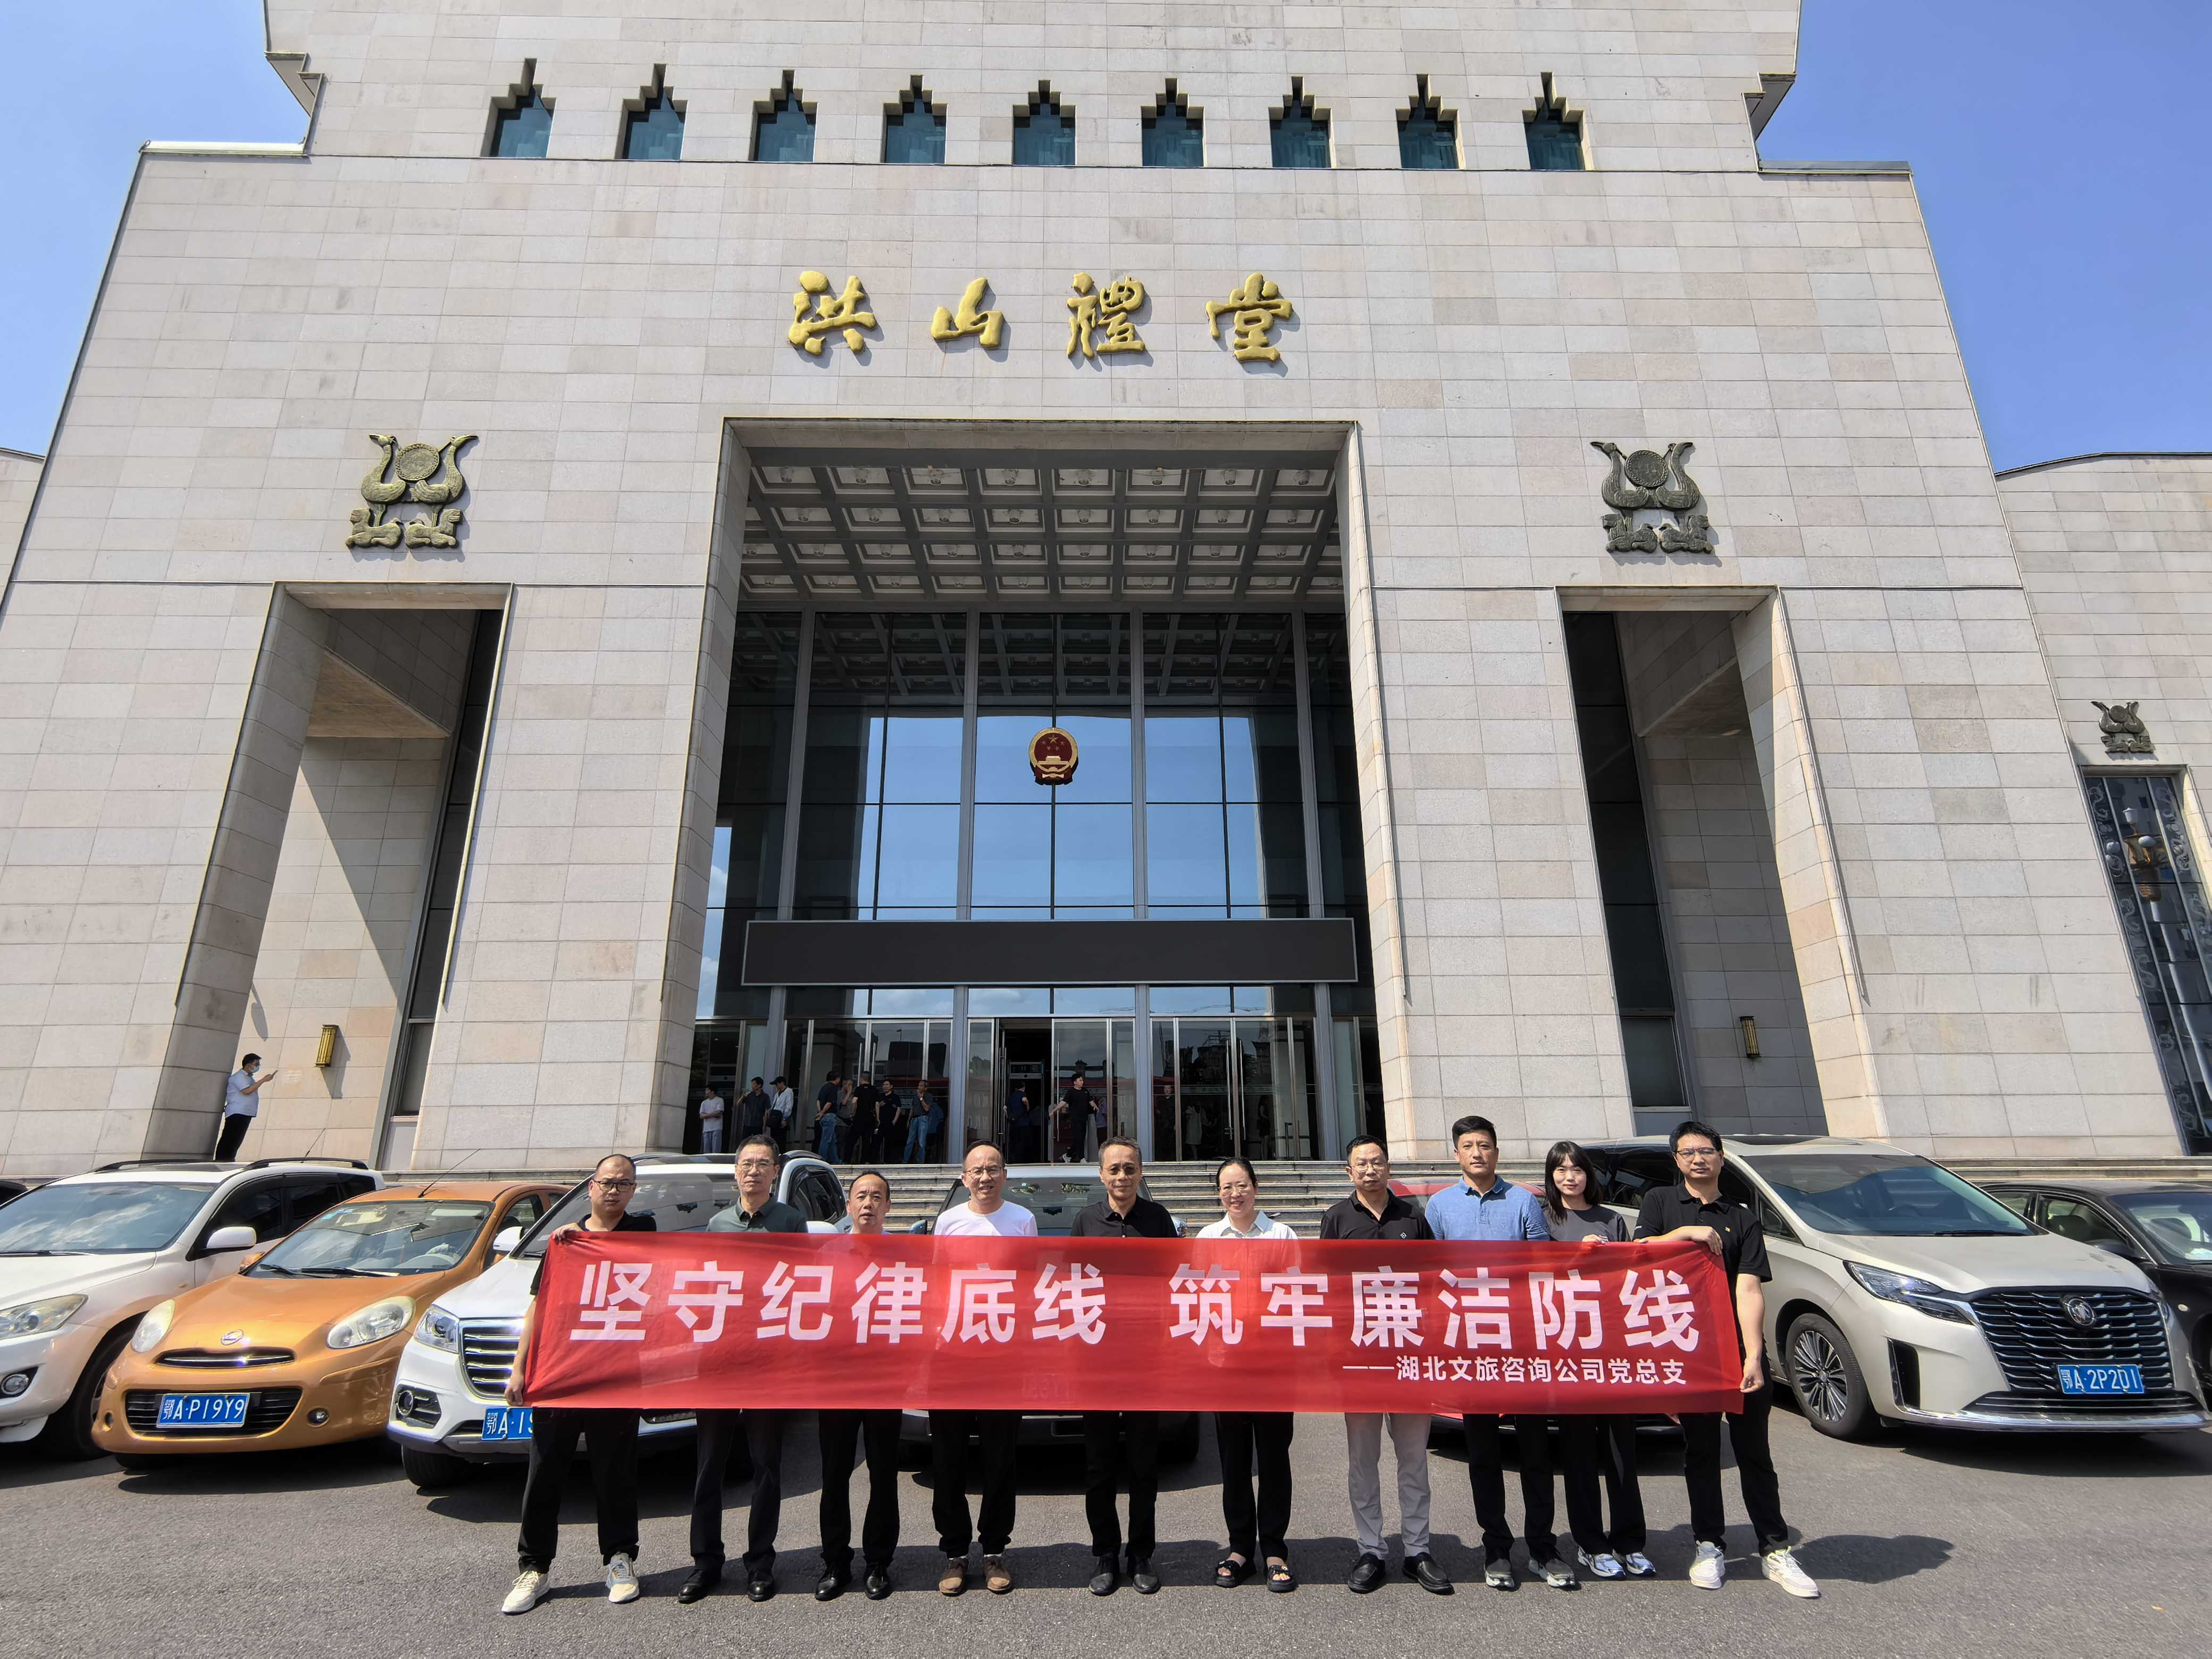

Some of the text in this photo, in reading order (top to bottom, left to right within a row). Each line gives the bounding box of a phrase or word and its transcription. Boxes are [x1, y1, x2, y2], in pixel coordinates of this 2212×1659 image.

[570, 1260, 1699, 1352] 坚守纪律底线 筑牢廉洁防线
